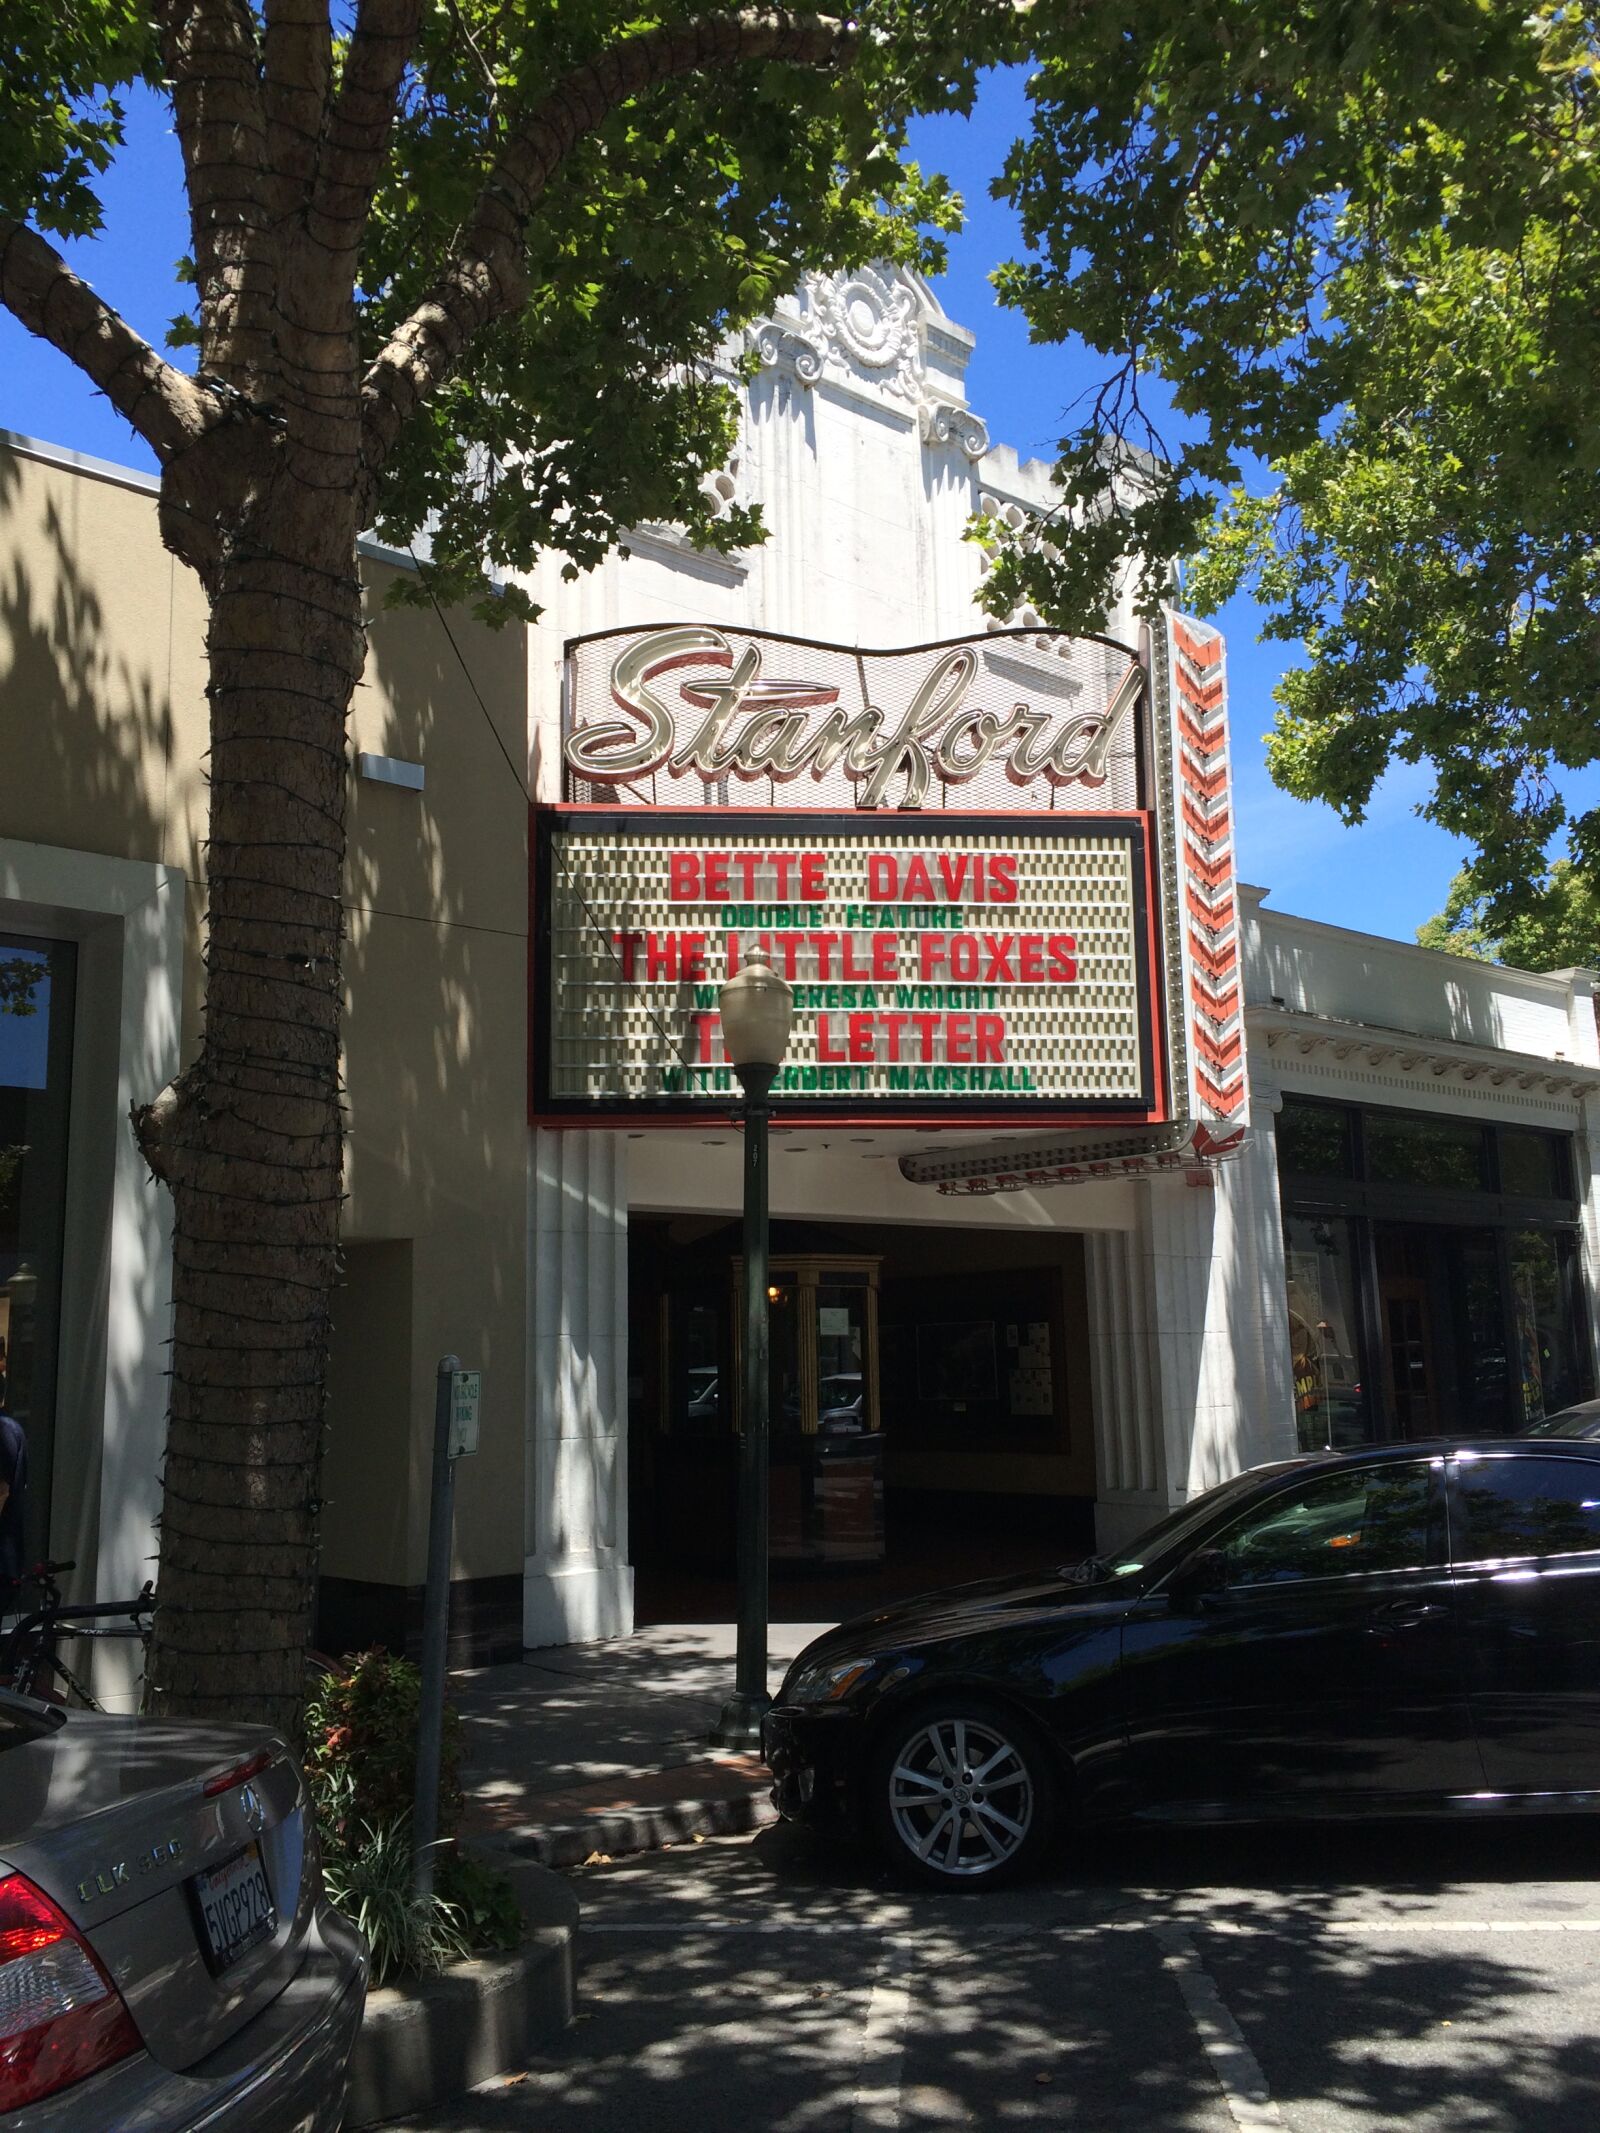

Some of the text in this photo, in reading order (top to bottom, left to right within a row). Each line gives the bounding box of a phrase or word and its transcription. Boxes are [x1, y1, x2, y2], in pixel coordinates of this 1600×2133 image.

[564, 625, 1147, 808] Stanford
[670, 853, 1018, 903] BETTE DAVIS
[721, 905, 964, 930] DOUBLE FEATURE
[613, 933, 707, 982] THE
[920, 934, 1077, 983] FOXES
[792, 984, 998, 1010] ERESA WRIGHT
[817, 1013, 1006, 1063] LETTER
[661, 1065, 1037, 1092] WITH RBERT MARSHALL
[77, 1861, 131, 1904] CLK
[204, 1870, 270, 1953] 5VGP928
